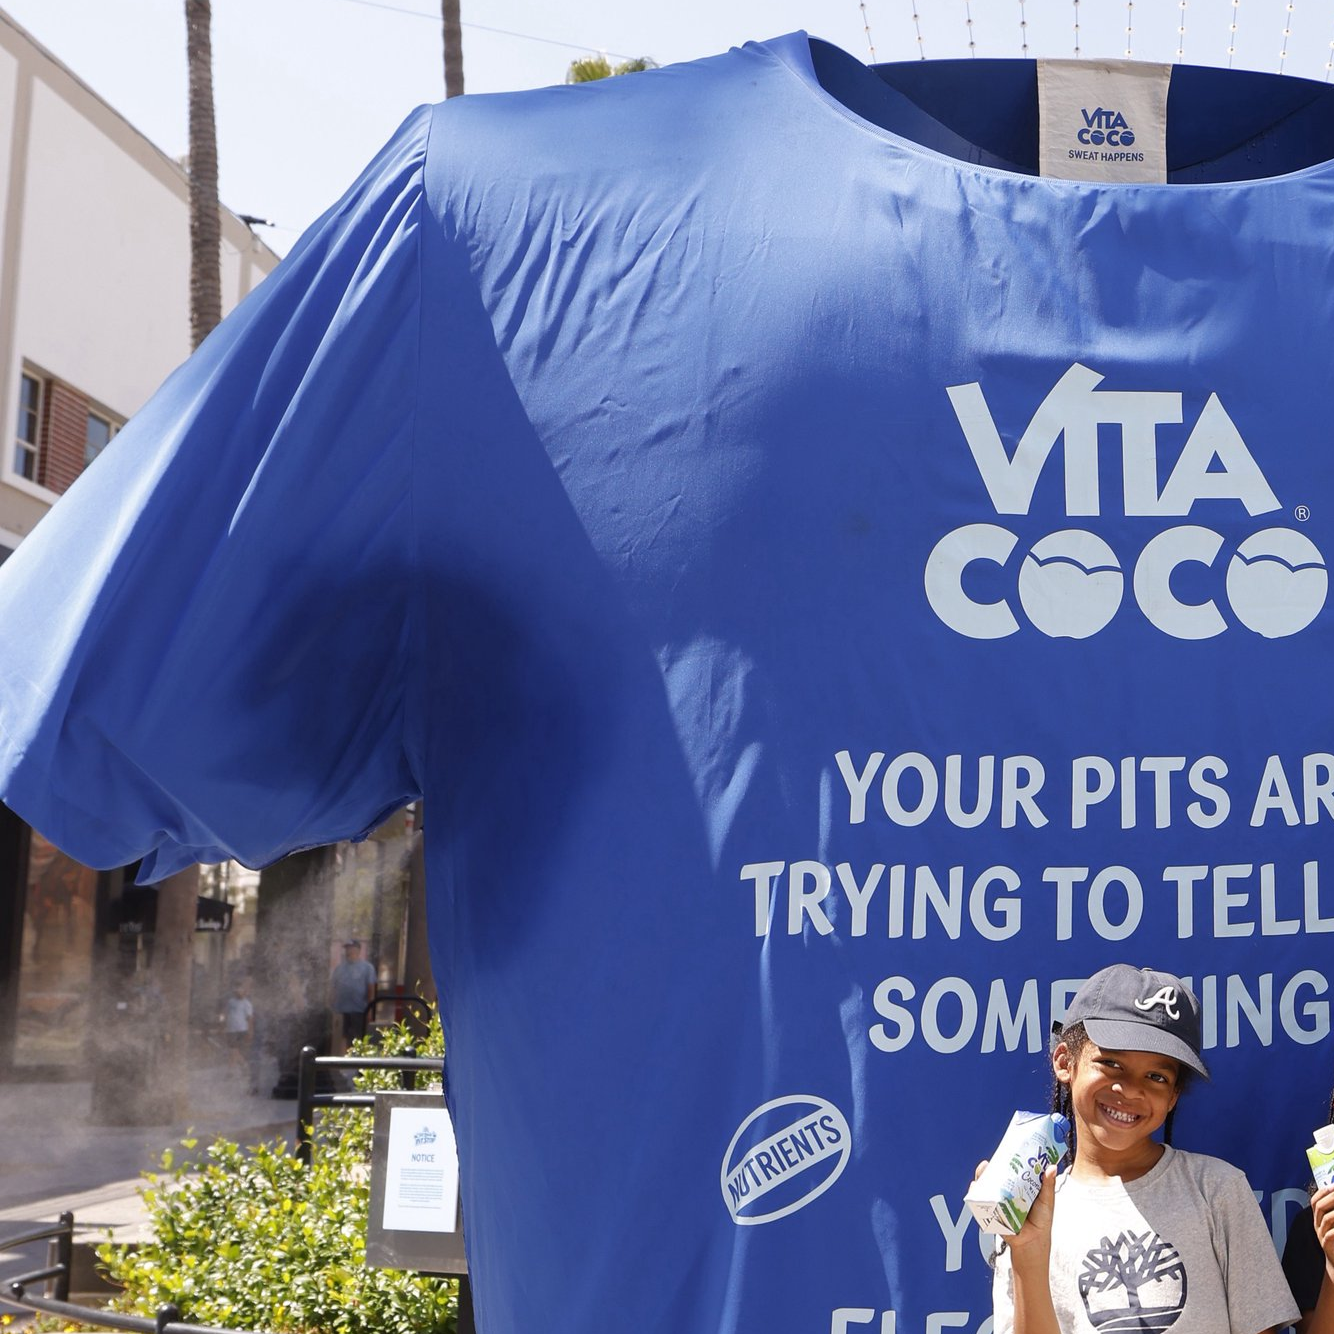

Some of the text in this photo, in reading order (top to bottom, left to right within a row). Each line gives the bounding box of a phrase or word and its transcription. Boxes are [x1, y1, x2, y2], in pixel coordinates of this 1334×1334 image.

[1078, 128, 1135, 146] COCO
[1081, 107, 1129, 129] VITA
[1069, 150, 1144, 162] SWEAT HAPPENS
[945, 362, 1283, 517] VITA
[924, 523, 1328, 640] COCO
[835, 750, 1050, 829] YOUR
[1070, 755, 1232, 829] PITS
[740, 860, 1024, 941] TRYING
[1042, 865, 1144, 941] TO
[1135, 986, 1180, 1021] A
[411, 1153, 435, 1163] NOTICE
[727, 1115, 842, 1208] NUTRIENTS
